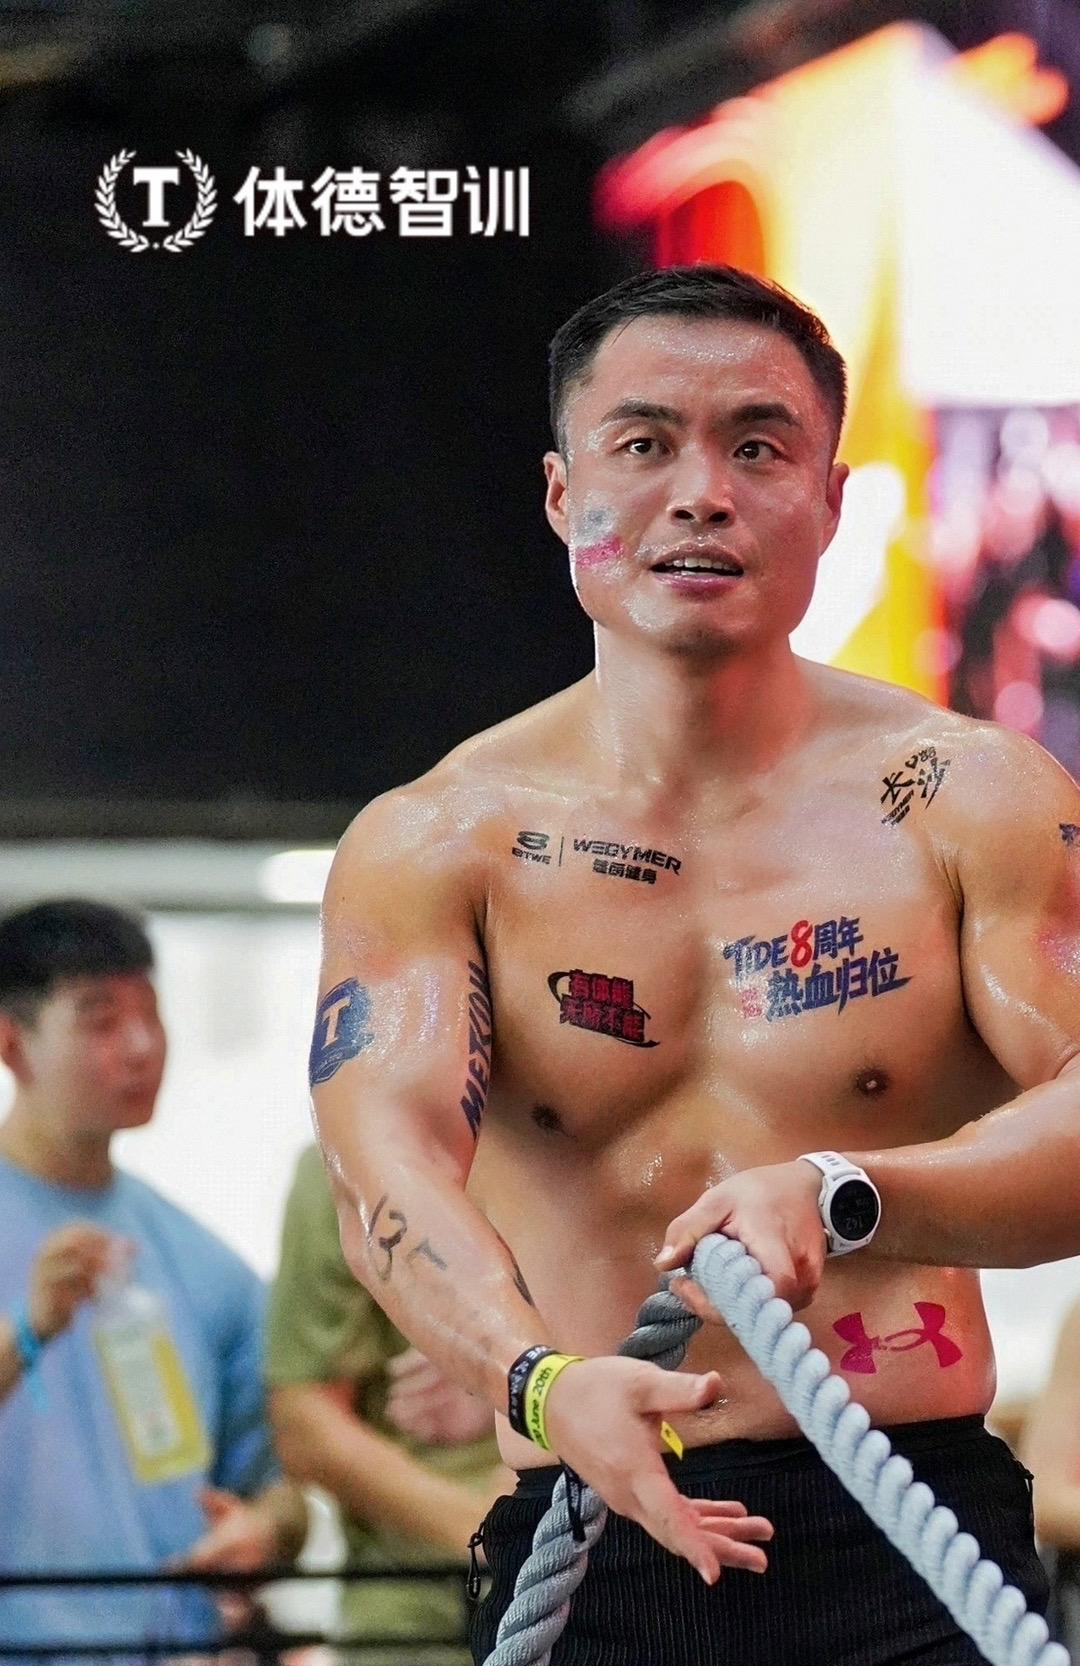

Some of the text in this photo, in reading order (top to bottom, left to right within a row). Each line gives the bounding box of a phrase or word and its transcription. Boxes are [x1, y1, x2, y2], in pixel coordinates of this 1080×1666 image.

[512, 847, 552, 865] BTWE
[573, 838, 682, 876] WEGYMER
[765, 946, 914, 1022] 热血归位
[532, 1366, 554, 1397] 20th
